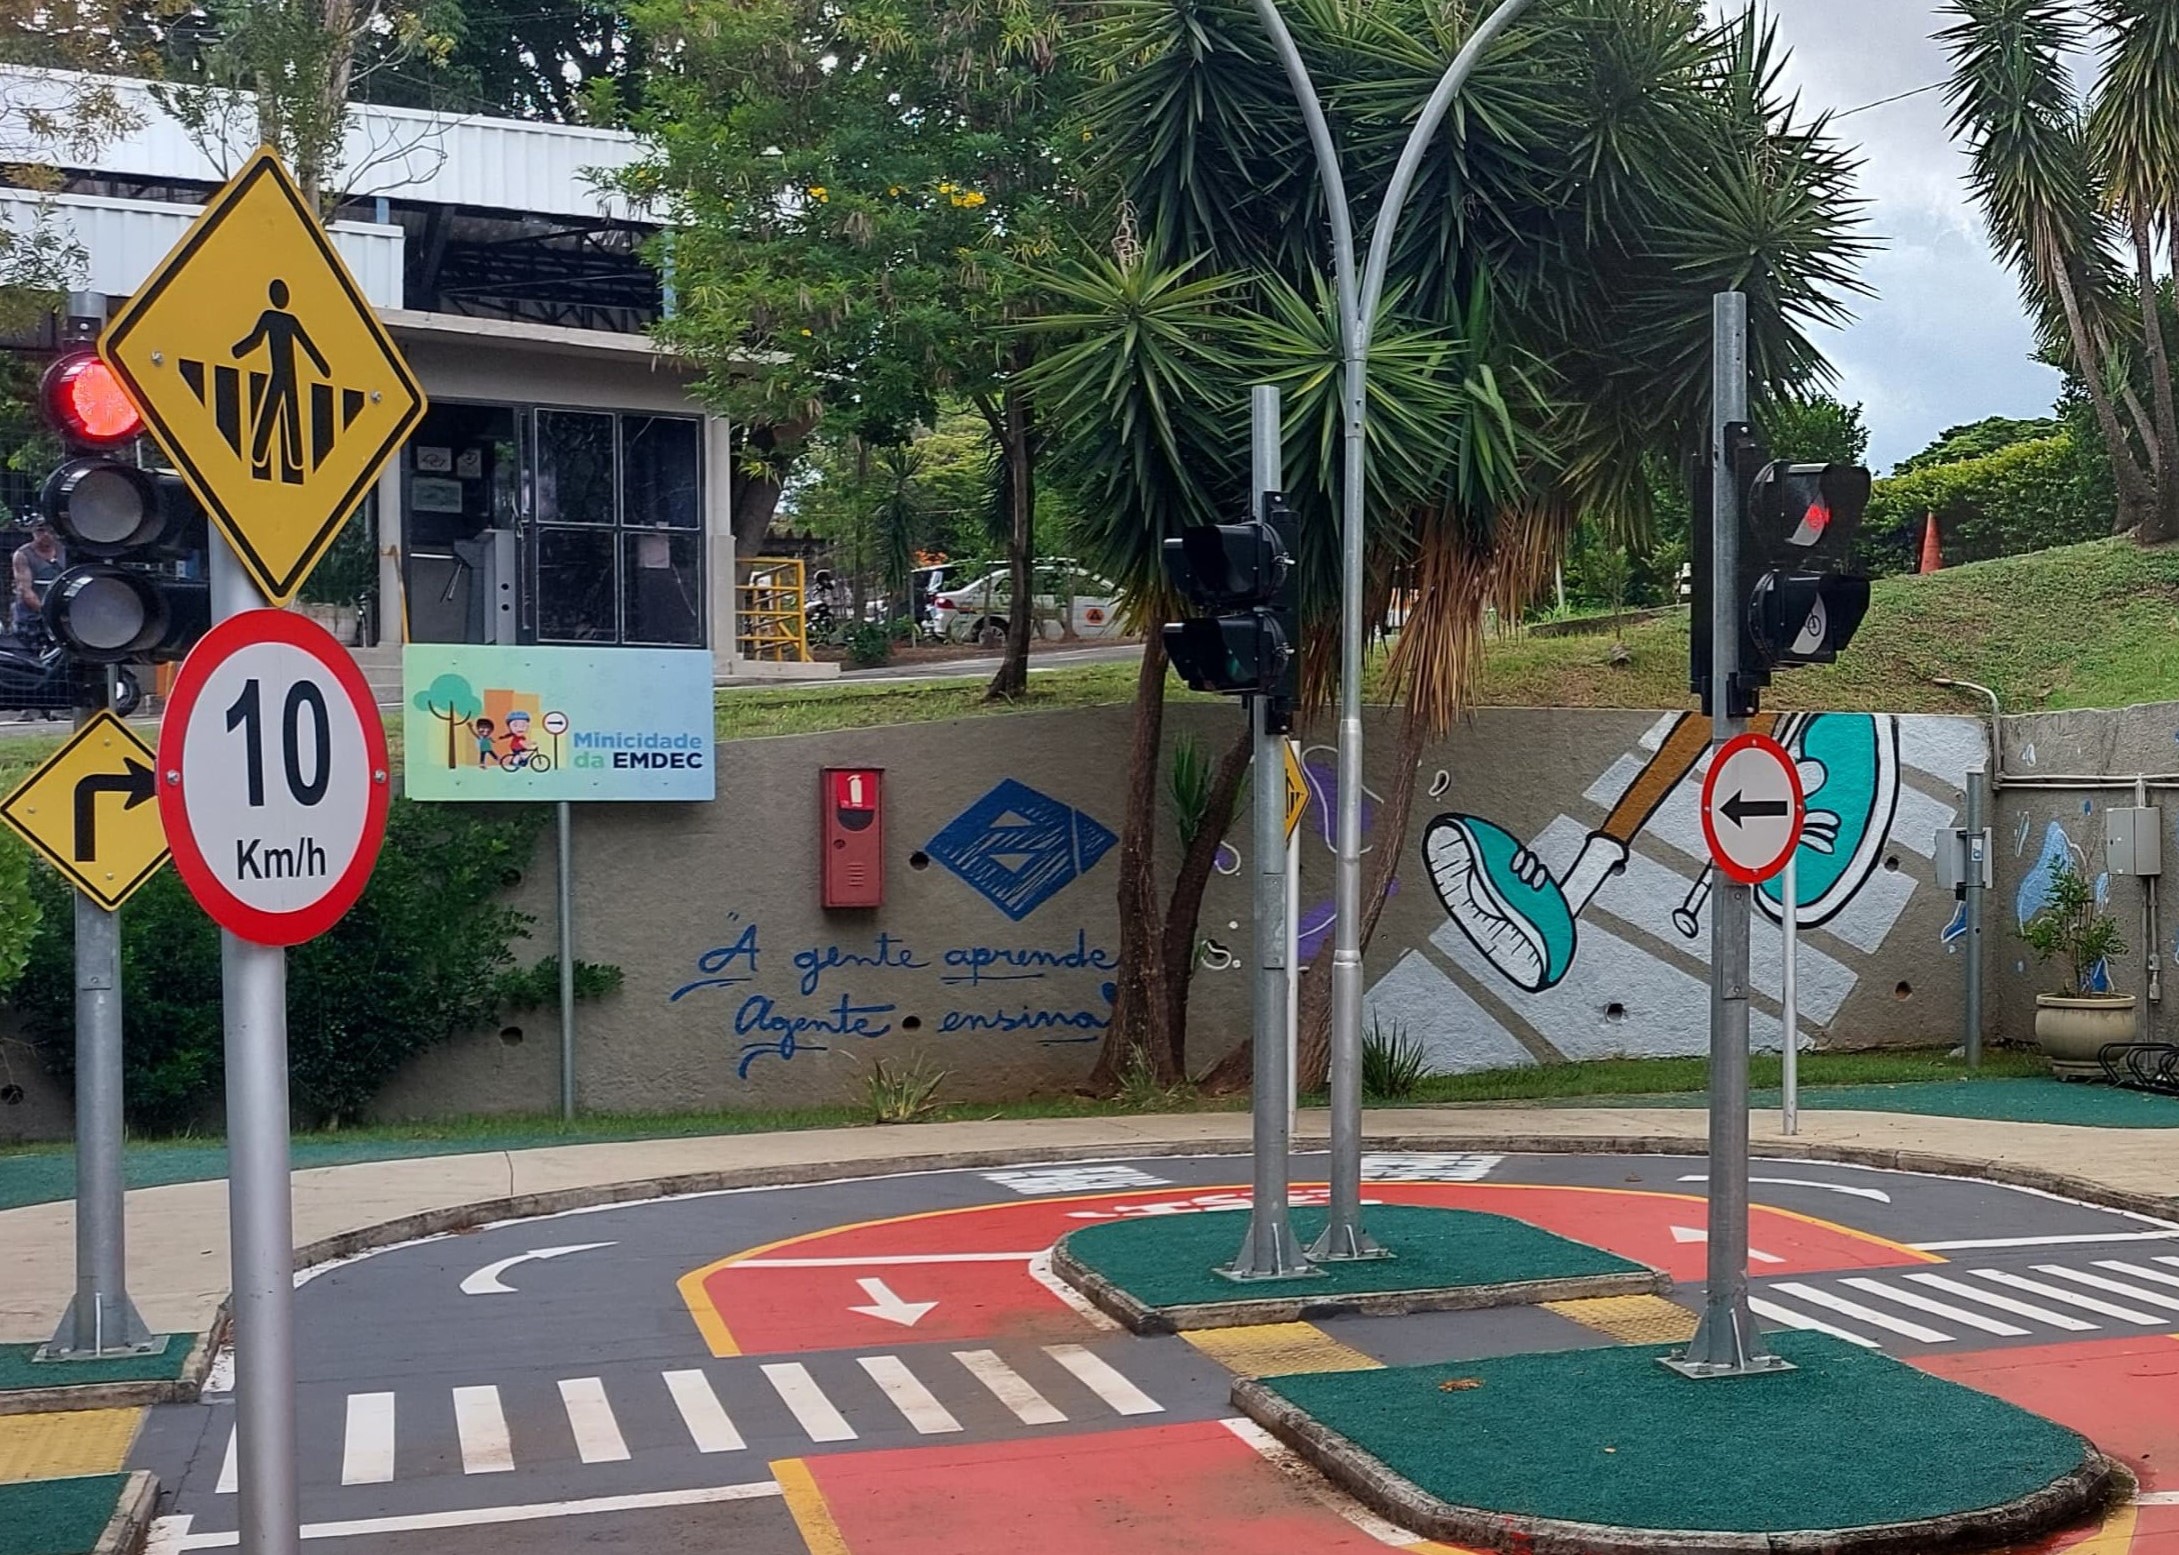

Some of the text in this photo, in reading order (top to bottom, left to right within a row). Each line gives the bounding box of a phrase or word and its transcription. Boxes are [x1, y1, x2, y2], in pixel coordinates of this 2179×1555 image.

[226, 678, 331, 807] 10
[573, 732, 703, 749] Minicidade
[574, 751, 704, 769] da EMDEC
[236, 836, 326, 880] Km/h
[793, 932, 931, 996] gente
[944, 928, 1118, 986] aprende
[734, 993, 896, 1061] Agente
